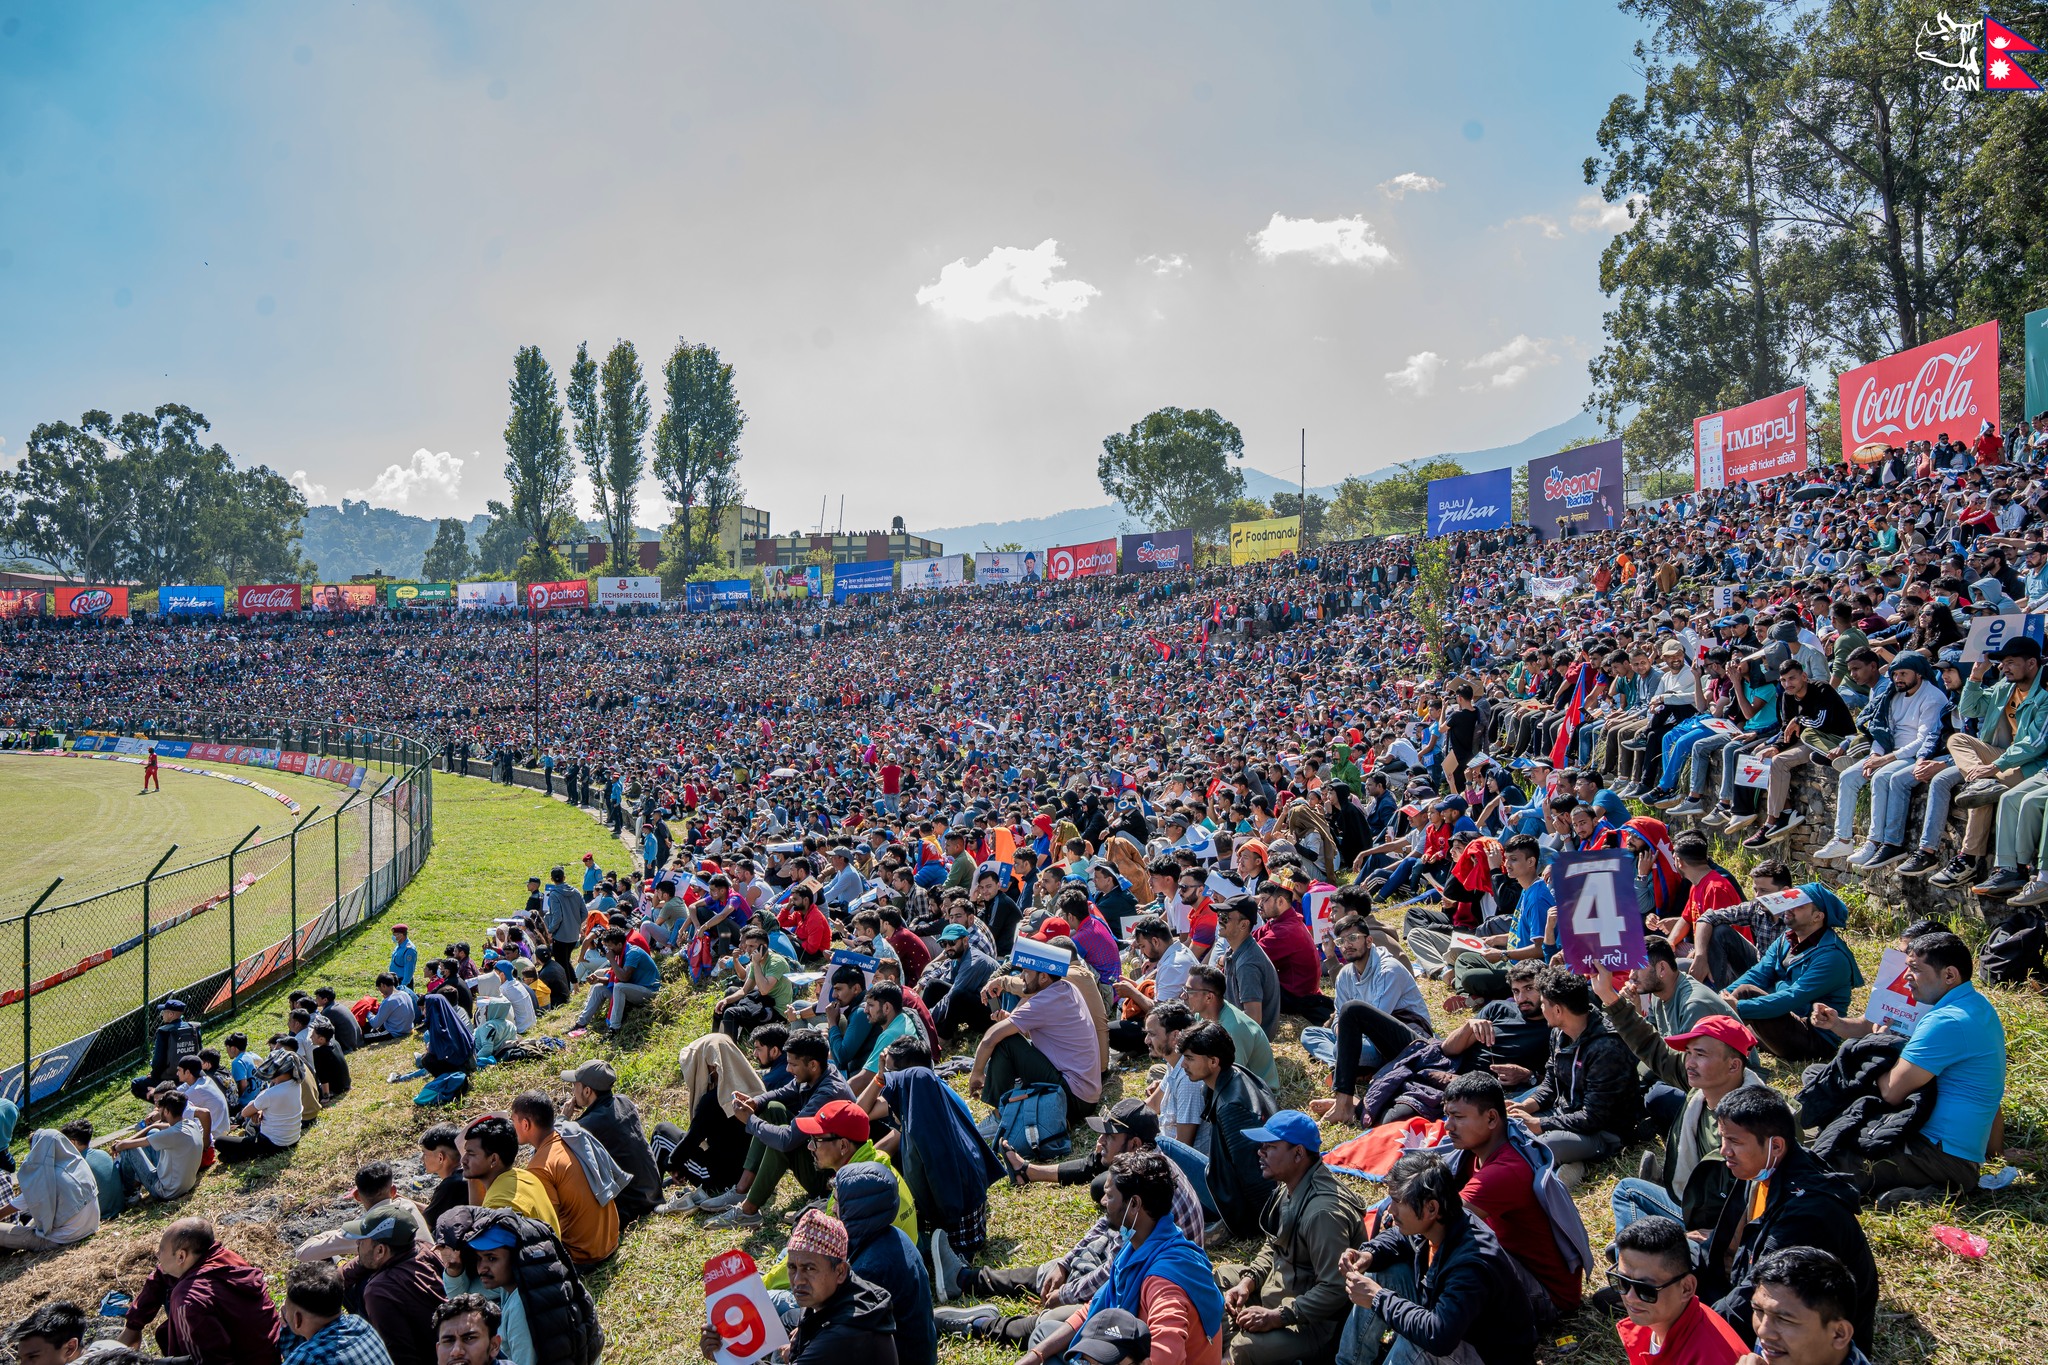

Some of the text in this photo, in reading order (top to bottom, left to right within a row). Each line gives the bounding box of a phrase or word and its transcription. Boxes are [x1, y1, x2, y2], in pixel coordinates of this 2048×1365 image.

[1852, 341, 1982, 443] Coca-Cola
[1550, 466, 1563, 482] My
[1728, 464, 1749, 476] Cricket
[1758, 457, 1776, 469] ticket
[1544, 467, 1602, 501] Second
[1438, 499, 1465, 511] BAJAJ
[1566, 493, 1593, 508] Teacher
[1437, 496, 1500, 533] pulsar
[1245, 526, 1298, 543] Foodmandu
[1137, 545, 1180, 562] Second
[1143, 541, 1155, 552] My
[1076, 552, 1113, 571] pathao
[76, 591, 110, 615] Real
[242, 588, 296, 608] Coca-Cola
[550, 588, 585, 601] pathao
[1572, 872, 1626, 947] 4
[176, 1040, 195, 1048] NEPAL
[176, 1046, 195, 1054] POLICE
[1104, 1330, 1122, 1339] adidas
